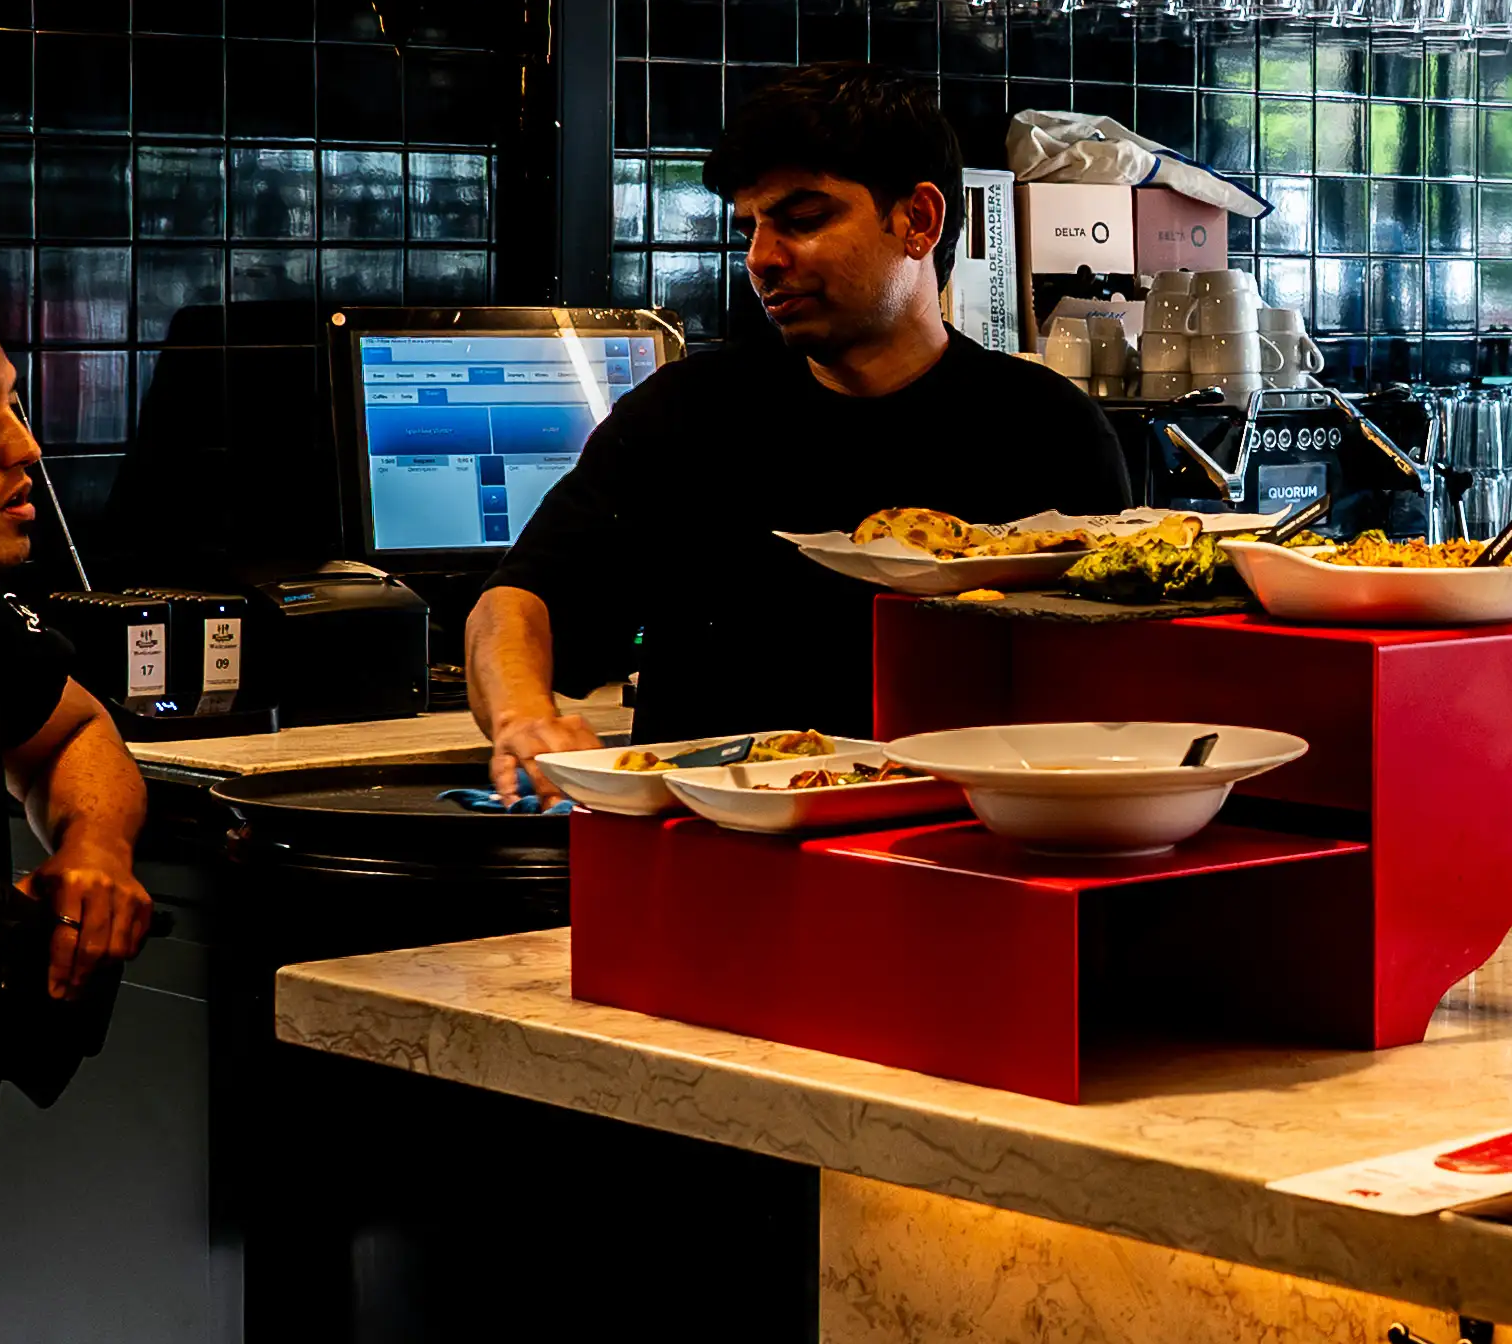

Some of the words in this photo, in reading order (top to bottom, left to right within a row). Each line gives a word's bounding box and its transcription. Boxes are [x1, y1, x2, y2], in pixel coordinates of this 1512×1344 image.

[987, 183, 996, 249] MADERA
[1054, 227, 1087, 237] DELTA
[989, 251, 997, 272] DE
[989, 275, 1000, 350] UBIERTOS
[1268, 485, 1318, 500] QUORUM
[140, 664, 155, 677] 17
[215, 657, 230, 670] 09
